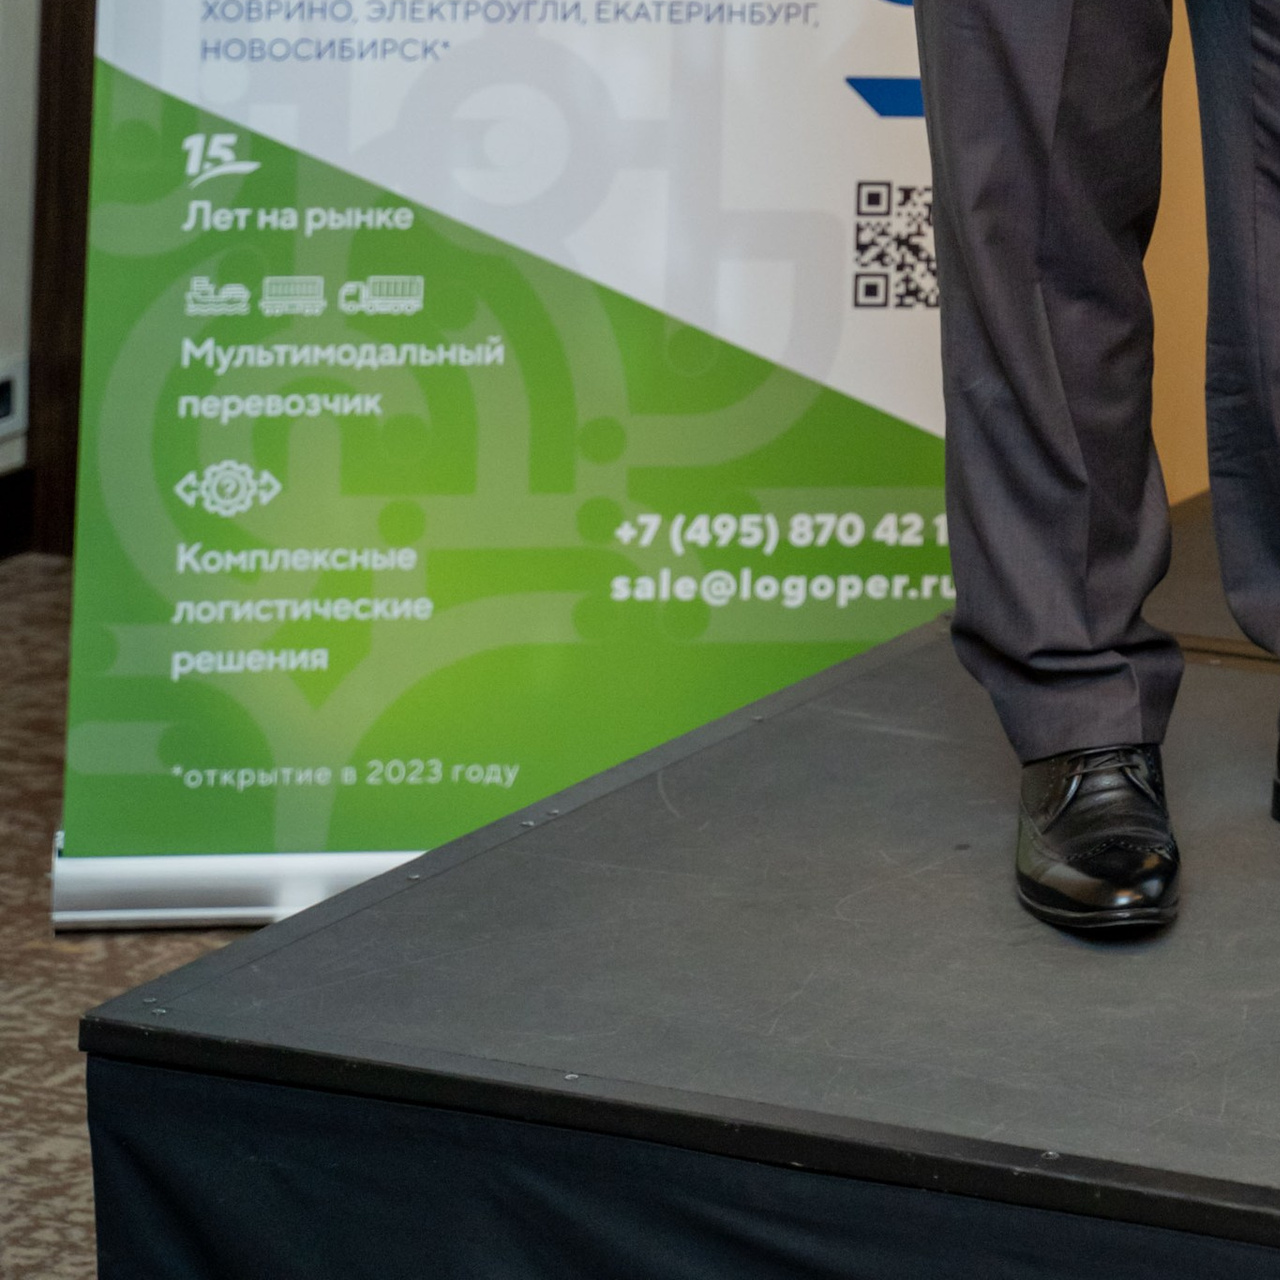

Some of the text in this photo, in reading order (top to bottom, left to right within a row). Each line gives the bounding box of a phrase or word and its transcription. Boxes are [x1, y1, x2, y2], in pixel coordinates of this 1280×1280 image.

[201, 0, 820, 28] ХОВРИНО, ЭЛЕКТРОУГЛИ, ЕКАТЕРИНБУРГ,
[181, 201, 414, 236] Лет на рынке
[181, 336, 505, 373] Мультимодальный
[178, 391, 383, 425] перевозчик
[615, 513, 661, 546] +7
[671, 514, 778, 555] (495)
[789, 513, 864, 547] 870
[873, 513, 924, 546] 42
[177, 543, 417, 573] Комплексные
[611, 567, 956, 608] sale@logoper.ru
[172, 597, 432, 623] логистические
[172, 648, 329, 680] решения
[340, 766, 357, 785] в
[366, 758, 443, 785] 2023
[452, 764, 519, 788] году
